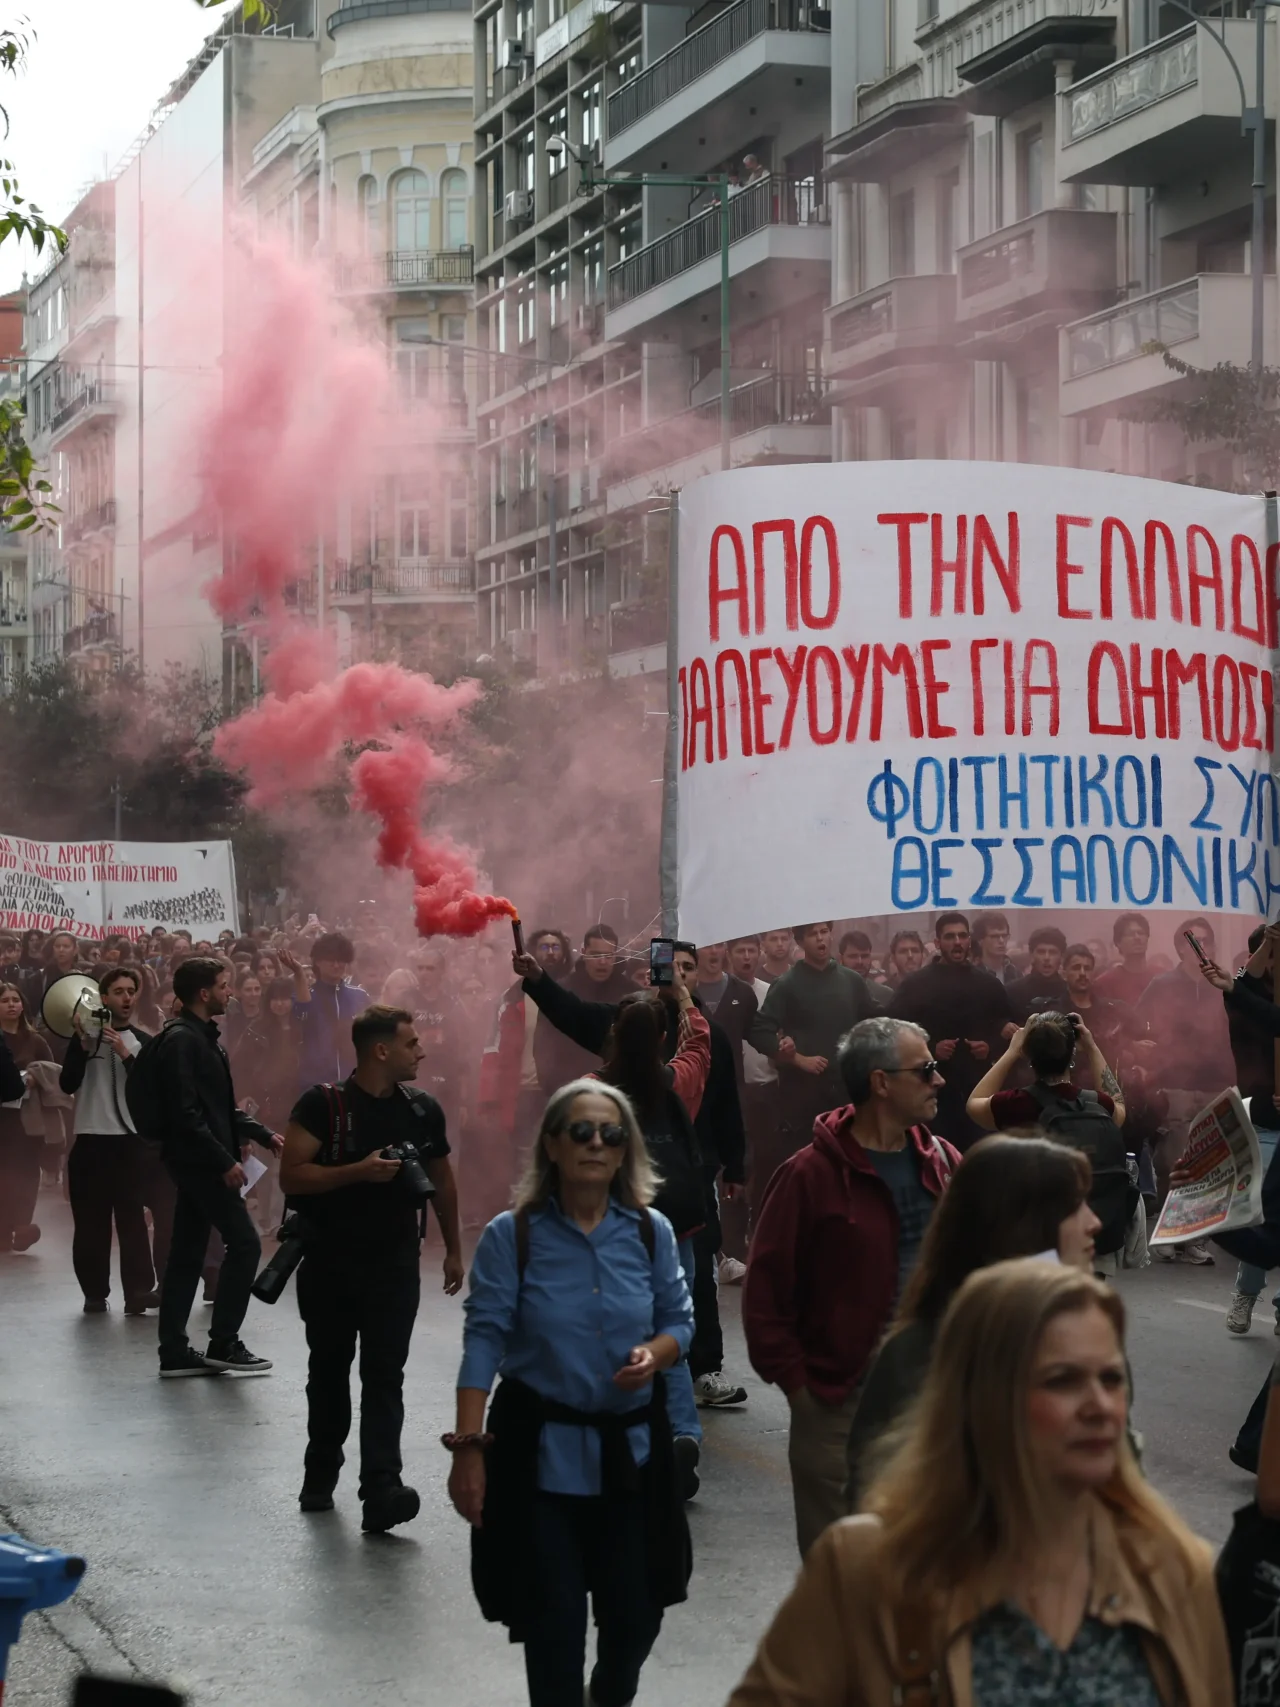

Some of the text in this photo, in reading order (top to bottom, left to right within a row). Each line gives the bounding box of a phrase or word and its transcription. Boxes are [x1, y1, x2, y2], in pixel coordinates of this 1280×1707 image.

[708, 514, 842, 643] ΑΠΟ
[877, 511, 1023, 619] ΤΗΝ
[970, 638, 1061, 737] ΓΙΑ
[867, 754, 1163, 840] ΦΟΙΤΗΤΙΚΟΙ
[58, 844, 115, 864] ΔΡΟΜΟΥΣ
[93, 865, 178, 882] ΠΑΝΕΠΙΣΤΗΜΙΟ
[1174, 1180, 1205, 1196] ΓΕΝΙΚΗ
